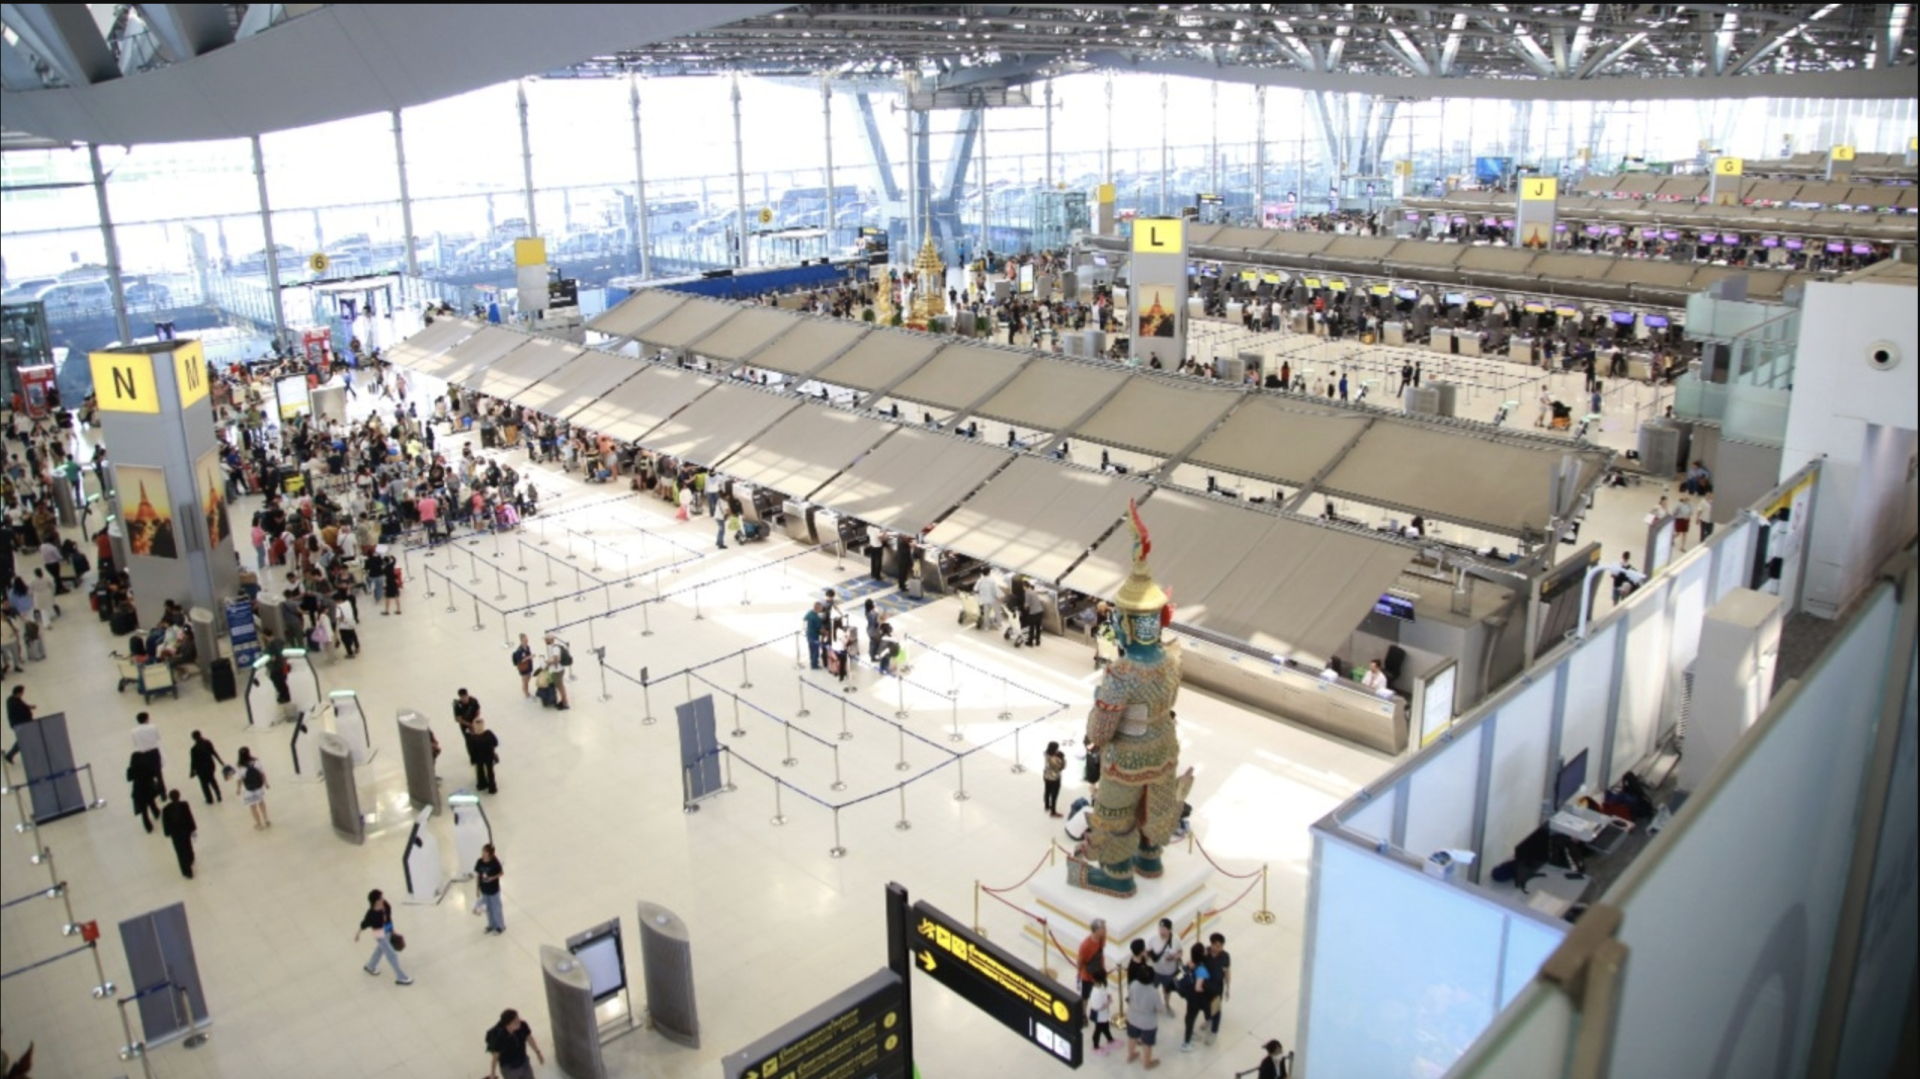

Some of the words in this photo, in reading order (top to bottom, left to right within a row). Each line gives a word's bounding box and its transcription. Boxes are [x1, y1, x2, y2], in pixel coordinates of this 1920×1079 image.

[1724, 160, 1734, 172] G
[1535, 182, 1544, 196] J
[1151, 226, 1164, 247] L
[315, 256, 325, 270] 6
[184, 356, 200, 392] M
[112, 366, 137, 400] N
